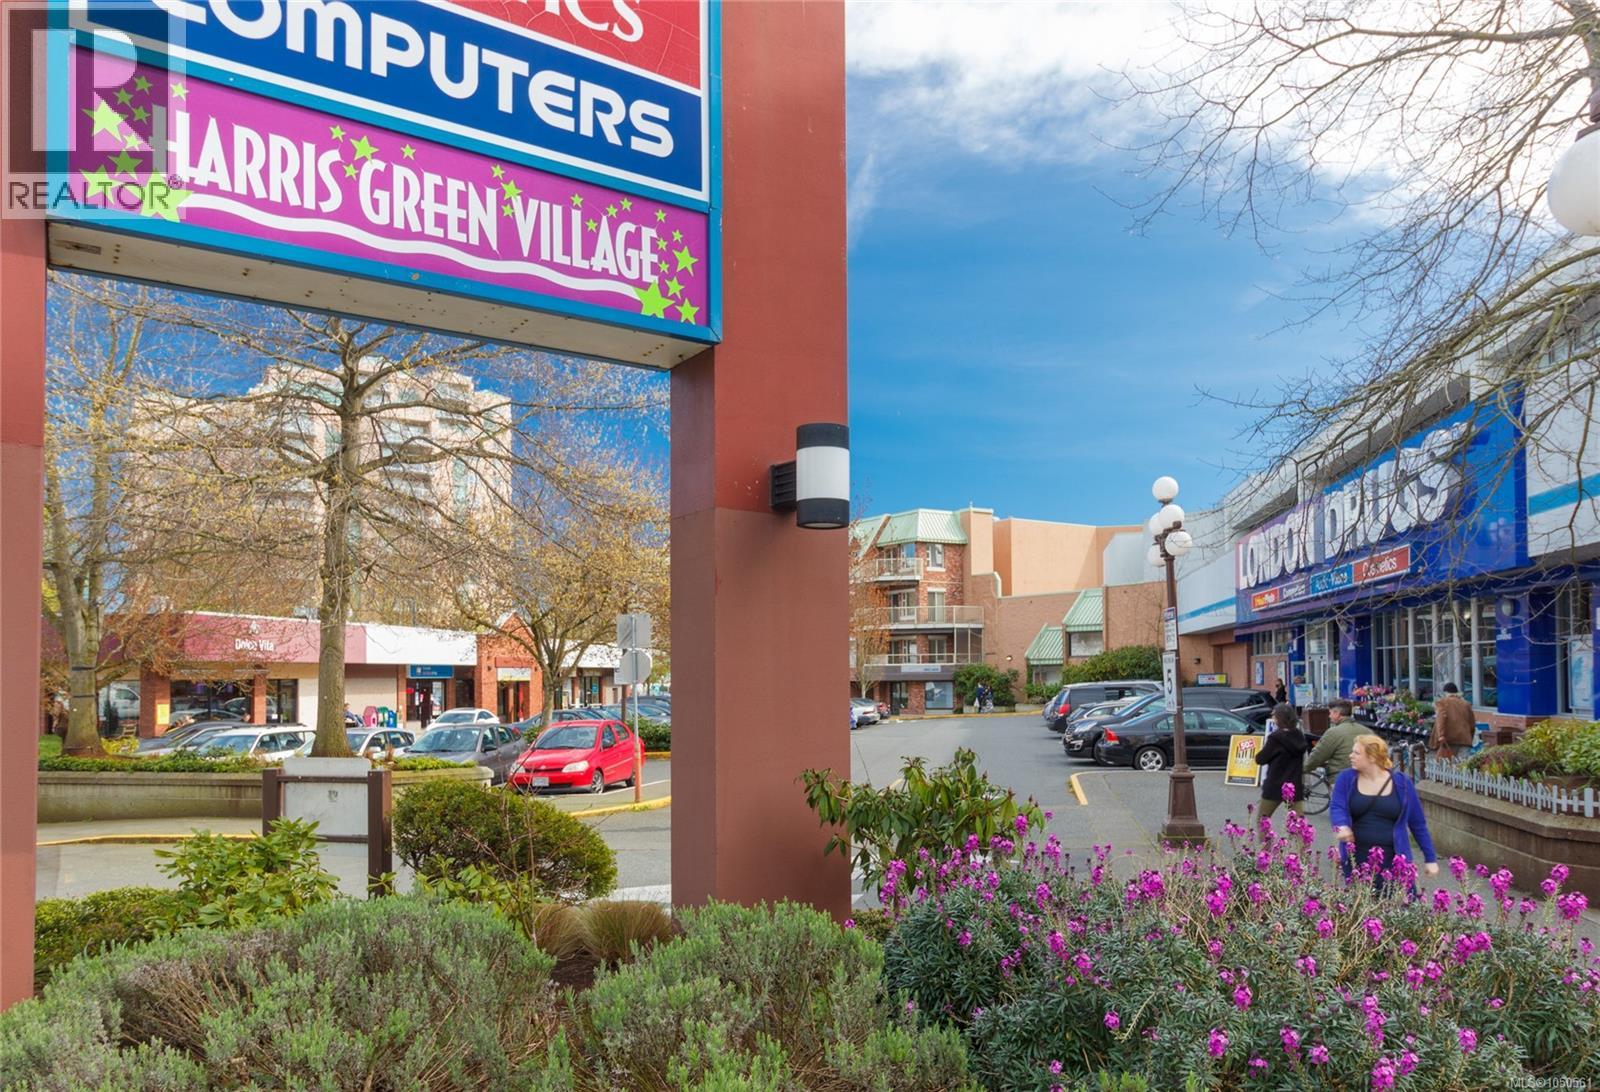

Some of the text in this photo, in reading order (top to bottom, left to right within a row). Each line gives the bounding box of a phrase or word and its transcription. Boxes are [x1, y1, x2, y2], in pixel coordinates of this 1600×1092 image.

[150, 103, 660, 283] HARRIS GREEN VILLAGE
[1239, 500, 1324, 590] LONDON
[1167, 668, 1173, 694] 5
